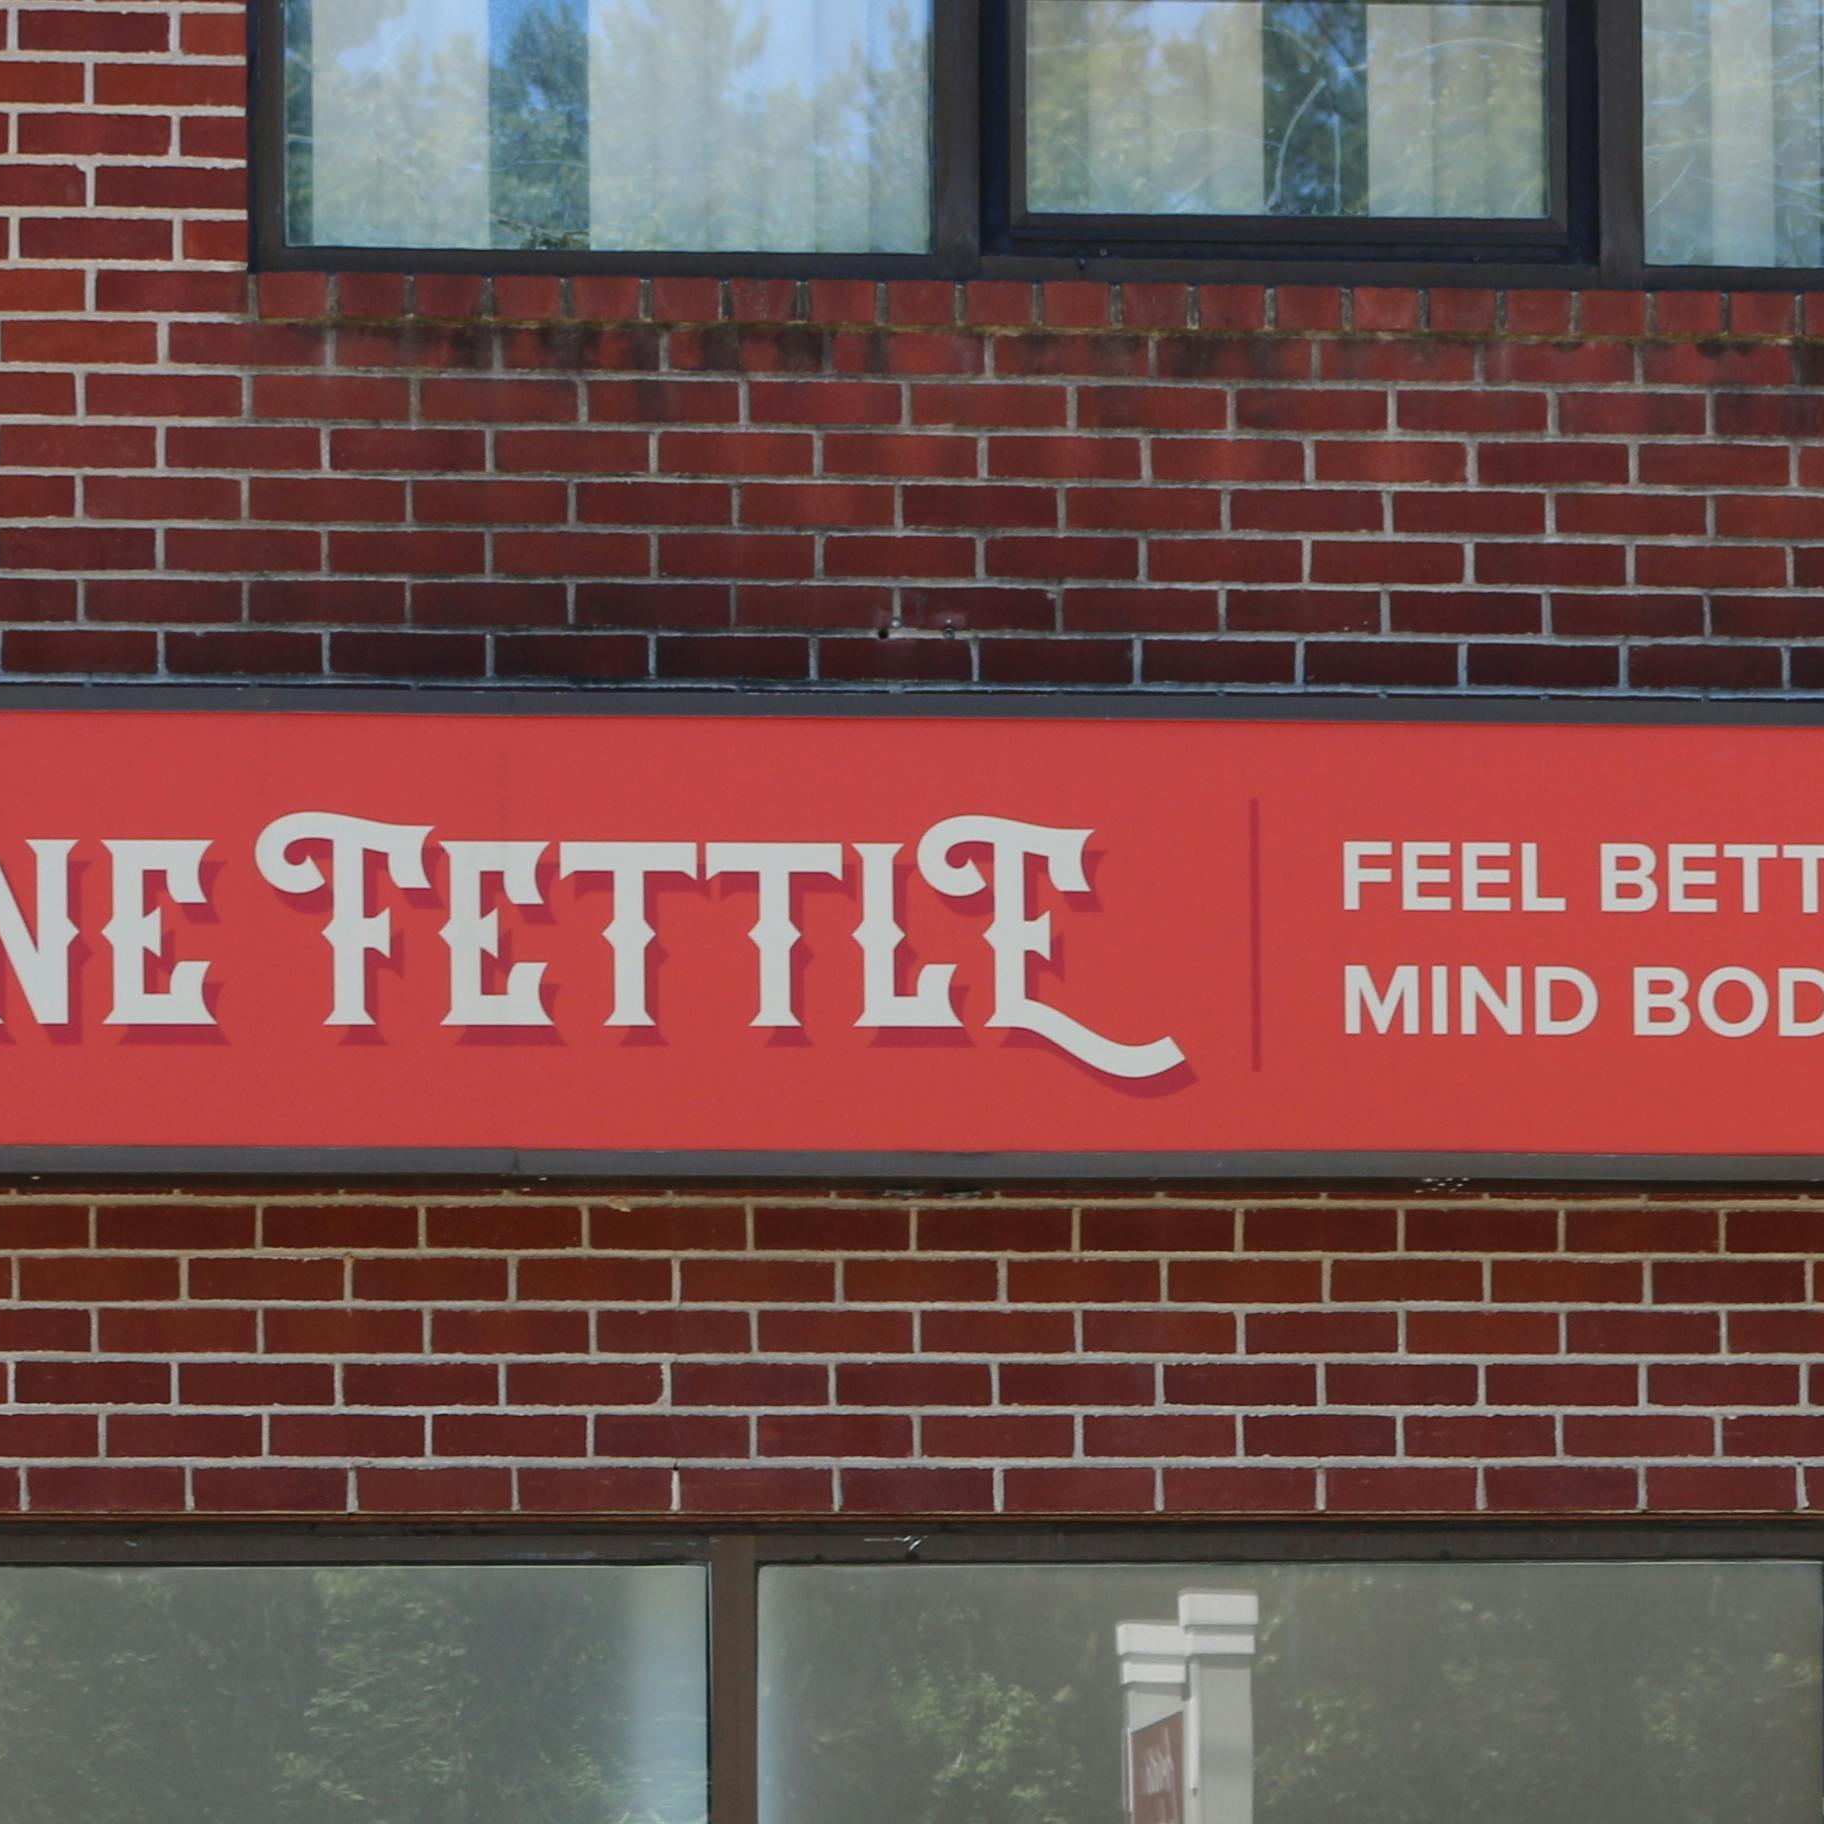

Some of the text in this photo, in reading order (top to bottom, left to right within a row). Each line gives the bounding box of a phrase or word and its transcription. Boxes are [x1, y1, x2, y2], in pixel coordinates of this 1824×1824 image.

[1344, 841, 1566, 911] FEEL
[255, 812, 1185, 1077] FETTLE
[1345, 965, 1598, 1035] MIND
